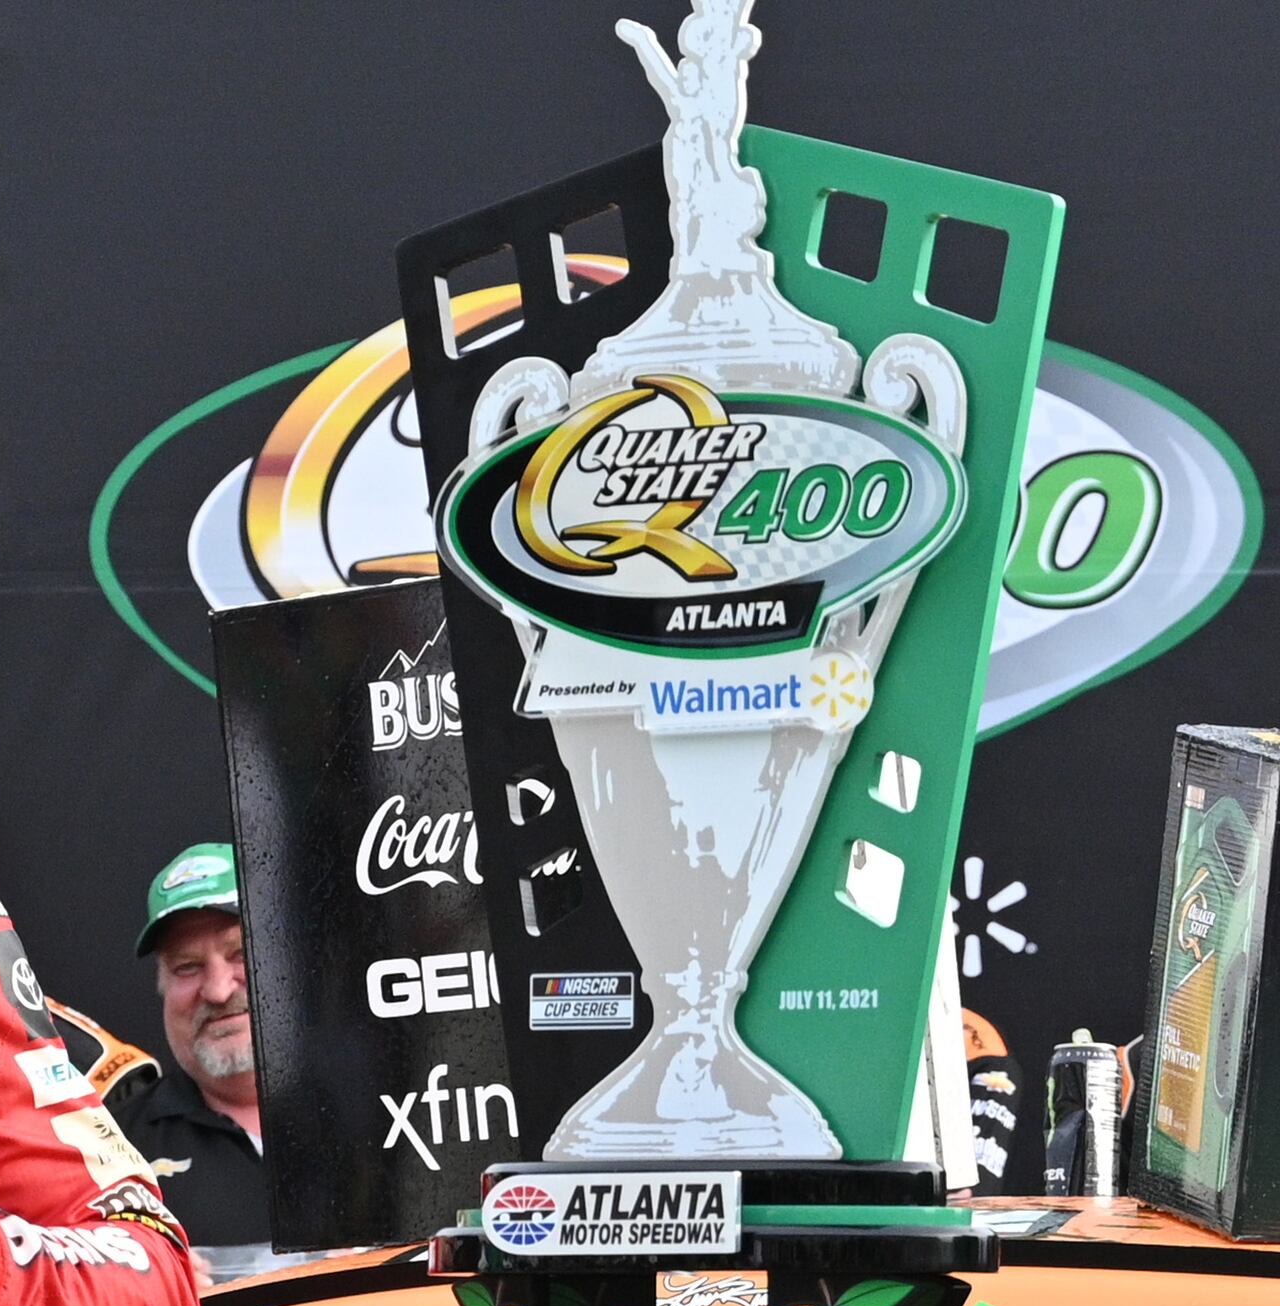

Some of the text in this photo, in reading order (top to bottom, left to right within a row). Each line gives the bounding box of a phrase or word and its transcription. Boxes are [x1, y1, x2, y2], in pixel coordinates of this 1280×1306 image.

[577, 421, 766, 473] QUAKER
[599, 461, 737, 506] STATE
[715, 460, 914, 544] 400
[666, 600, 787, 632] ATLANTA
[368, 671, 464, 751] BUS
[539, 675, 801, 715] Presented by Walmart
[1188, 904, 1216, 927] QUAKER
[1189, 922, 1209, 939] STATE
[366, 950, 501, 1018] GEI
[560, 977, 619, 995] NASCAR
[544, 1001, 619, 1018] CUP SERIES
[778, 988, 879, 1013] JULY 11, 2021
[1165, 1025, 1181, 1046] FULL
[1162, 1045, 1201, 1072] SYNTHETIC
[379, 1064, 520, 1171] xfin
[563, 1183, 725, 1221] ATLANTA
[559, 1221, 724, 1245] MOTOR SPEEDWAY
